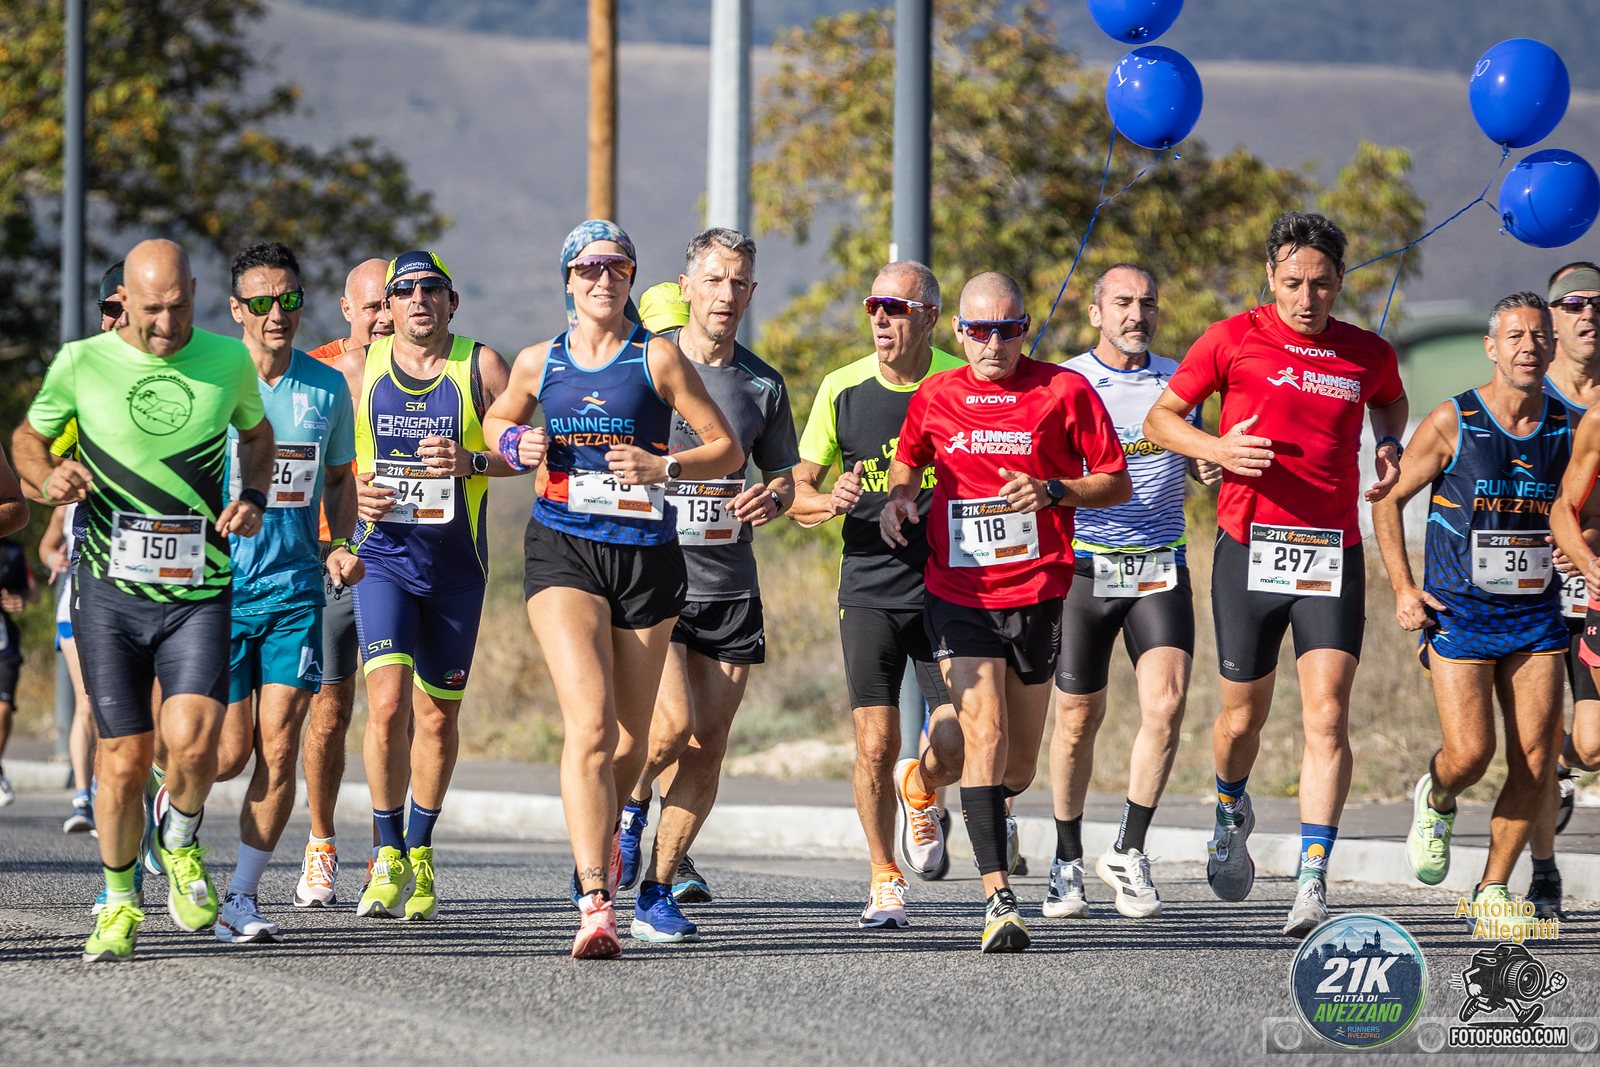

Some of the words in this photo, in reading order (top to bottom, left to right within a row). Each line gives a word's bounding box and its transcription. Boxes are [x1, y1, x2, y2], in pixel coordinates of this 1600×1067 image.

[1284, 343, 1337, 358] GIVOVA
[1302, 370, 1361, 393] RUNNERS
[965, 395, 1017, 405] GIVOVA
[1301, 381, 1361, 404] AVEZZANO
[405, 401, 427, 411] S74
[377, 414, 454, 436] BRIGANTI
[550, 416, 635, 434] RUNNERS
[554, 433, 636, 447] AVEZZANO
[971, 430, 1032, 444] RUNNERS
[971, 442, 1032, 455] AVEZZANO
[387, 466, 404, 476] 21K
[398, 480, 425, 502] 94
[677, 484, 699, 495] 21K
[1474, 479, 1557, 499] RUNNERS
[688, 499, 722, 522] 135
[962, 506, 980, 517] 21K
[131, 519, 154, 531] 21K
[974, 517, 1006, 543] 118
[1266, 529, 1288, 542] 21K
[1490, 536, 1511, 545] 21K
[142, 536, 177, 560] 150
[1123, 555, 1147, 576] 87
[1274, 546, 1317, 574] 297
[1505, 550, 1528, 572] 36
[1260, 577, 1290, 585] movimedica
[367, 638, 393, 655] S74
